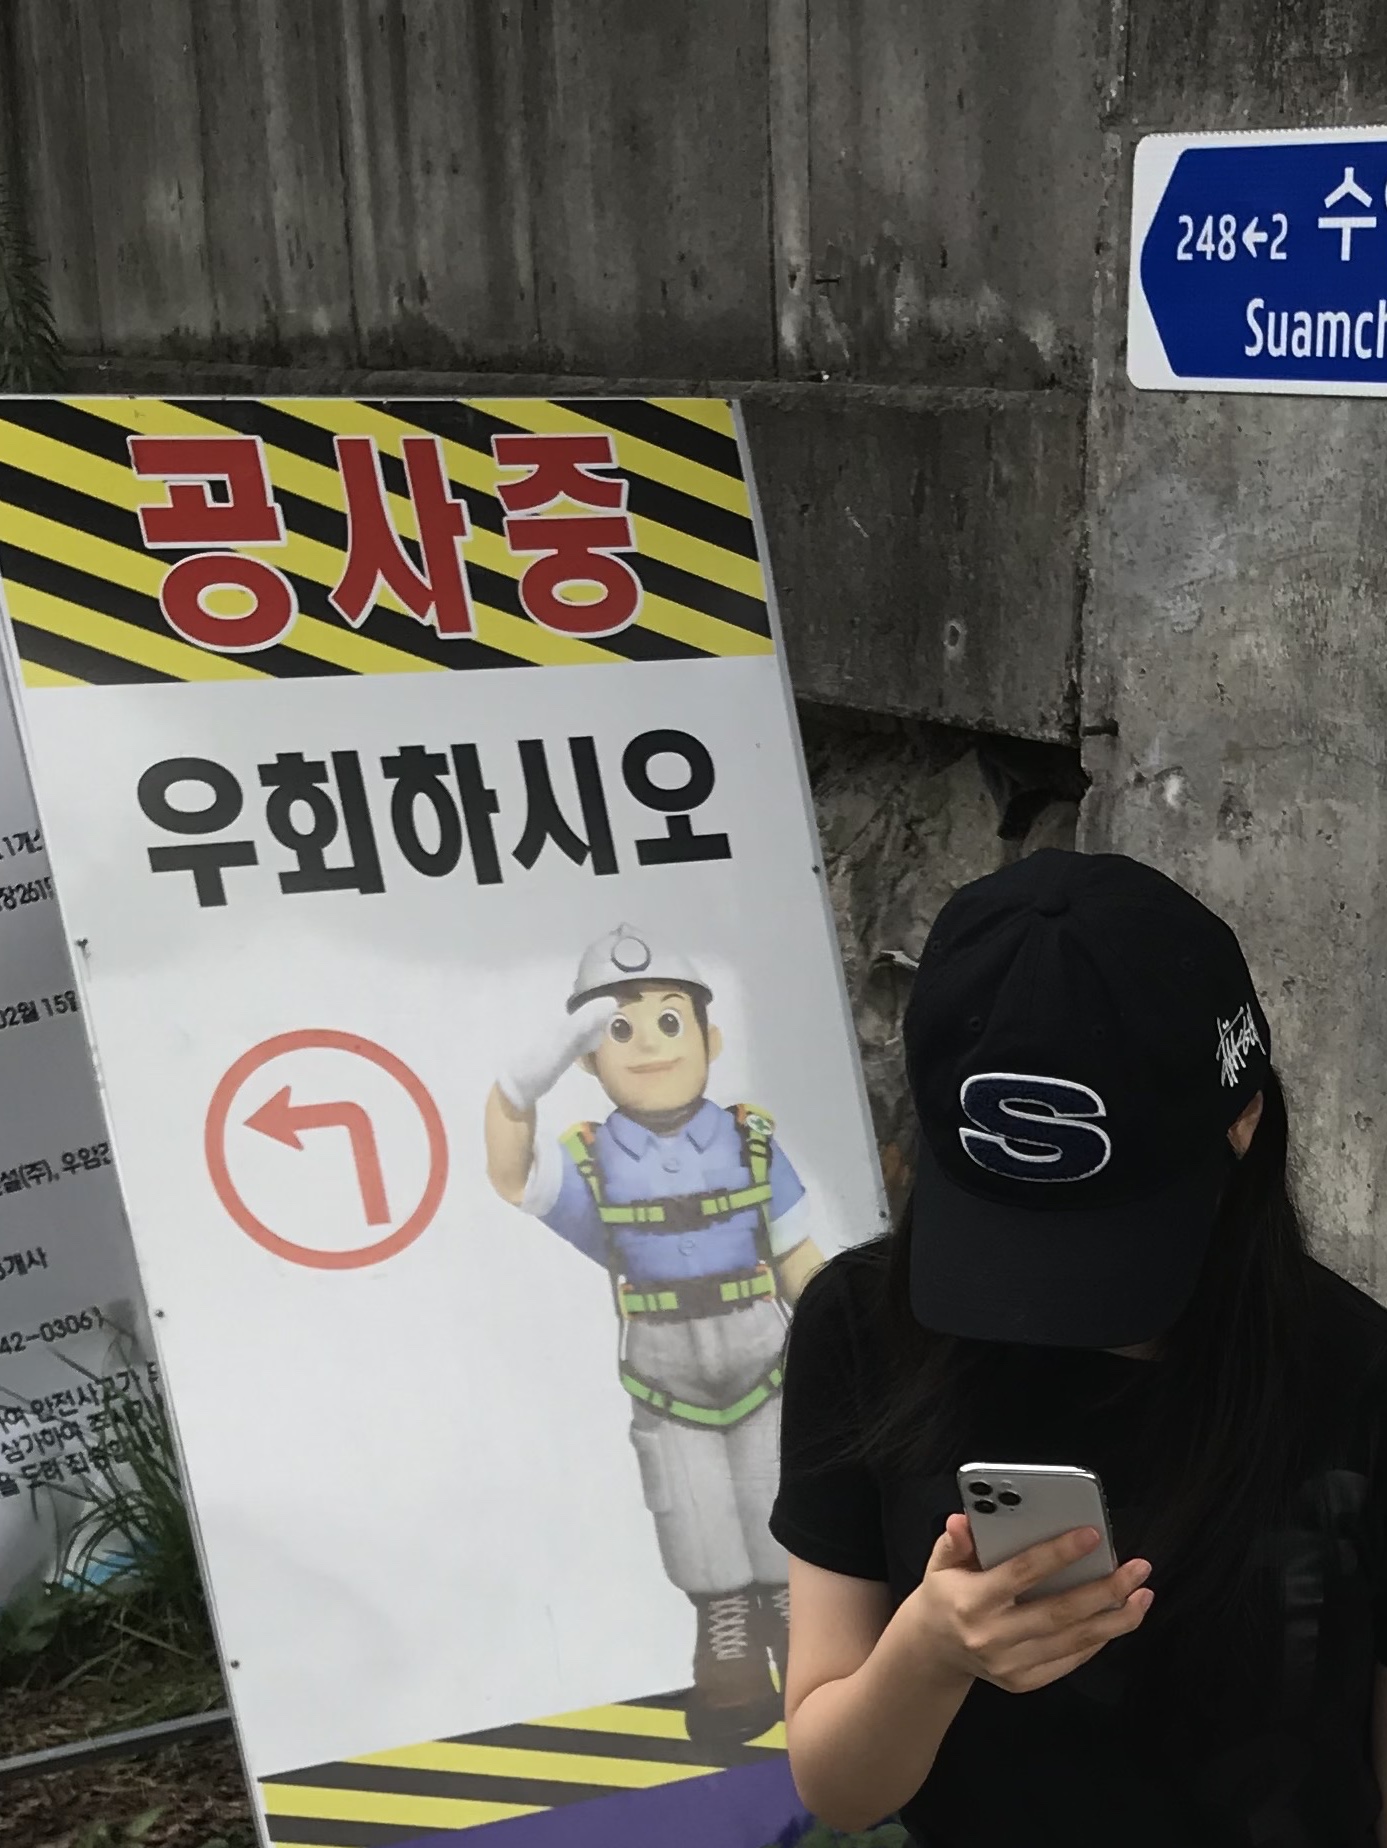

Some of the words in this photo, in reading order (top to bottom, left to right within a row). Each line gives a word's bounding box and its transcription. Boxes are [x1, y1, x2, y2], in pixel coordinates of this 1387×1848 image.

[126, 433, 644, 654] 공사중
[136, 728, 733, 909] 우회하시오
[958, 1071, 1112, 1183] S
